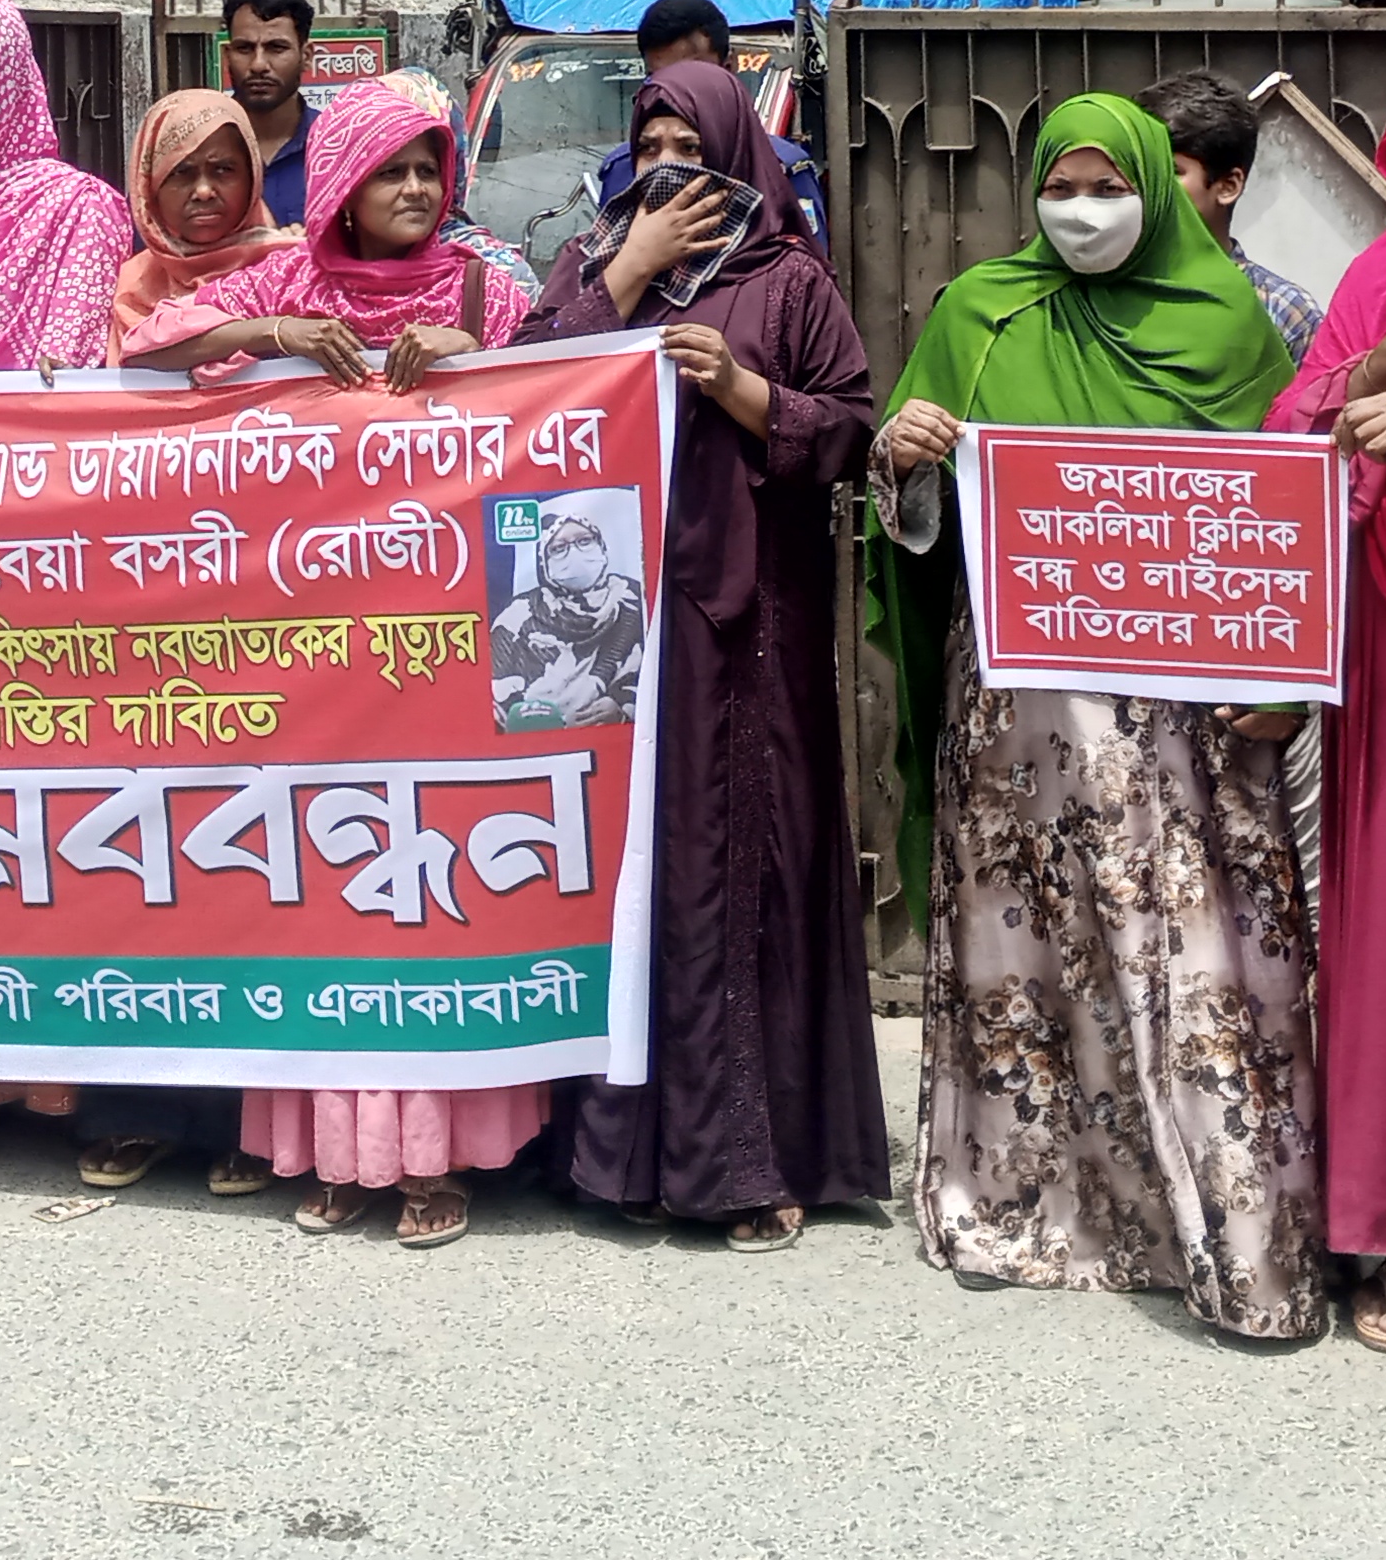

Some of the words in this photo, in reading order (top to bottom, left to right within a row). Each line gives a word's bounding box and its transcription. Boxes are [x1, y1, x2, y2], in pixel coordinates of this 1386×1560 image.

[63, 397, 345, 502] ডায়াগনস্টিক
[352, 389, 516, 499] সেন্টার
[524, 385, 607, 492] এর
[1055, 461, 1258, 506] জমরাজের
[107, 509, 249, 589] বসরী
[267, 495, 472, 597] (রোজী)
[1016, 500, 1175, 550] আকলিমা
[1182, 504, 1302, 555] ক্লিনিক
[1008, 555, 1083, 597] বন্ধ
[1092, 562, 1125, 590] ও
[1138, 550, 1313, 610] লাইসেন্স
[125, 615, 356, 675] নবজাতকের
[365, 613, 481, 690] মৃত্যুর
[1021, 596, 1199, 646] বাতিলের
[1209, 601, 1301, 652] দাবি
[111, 678, 285, 747] দাবিতে
[54, 968, 226, 1023] পরিবার
[243, 985, 283, 1020] ও
[305, 949, 587, 1026] এলাকাবাসী
